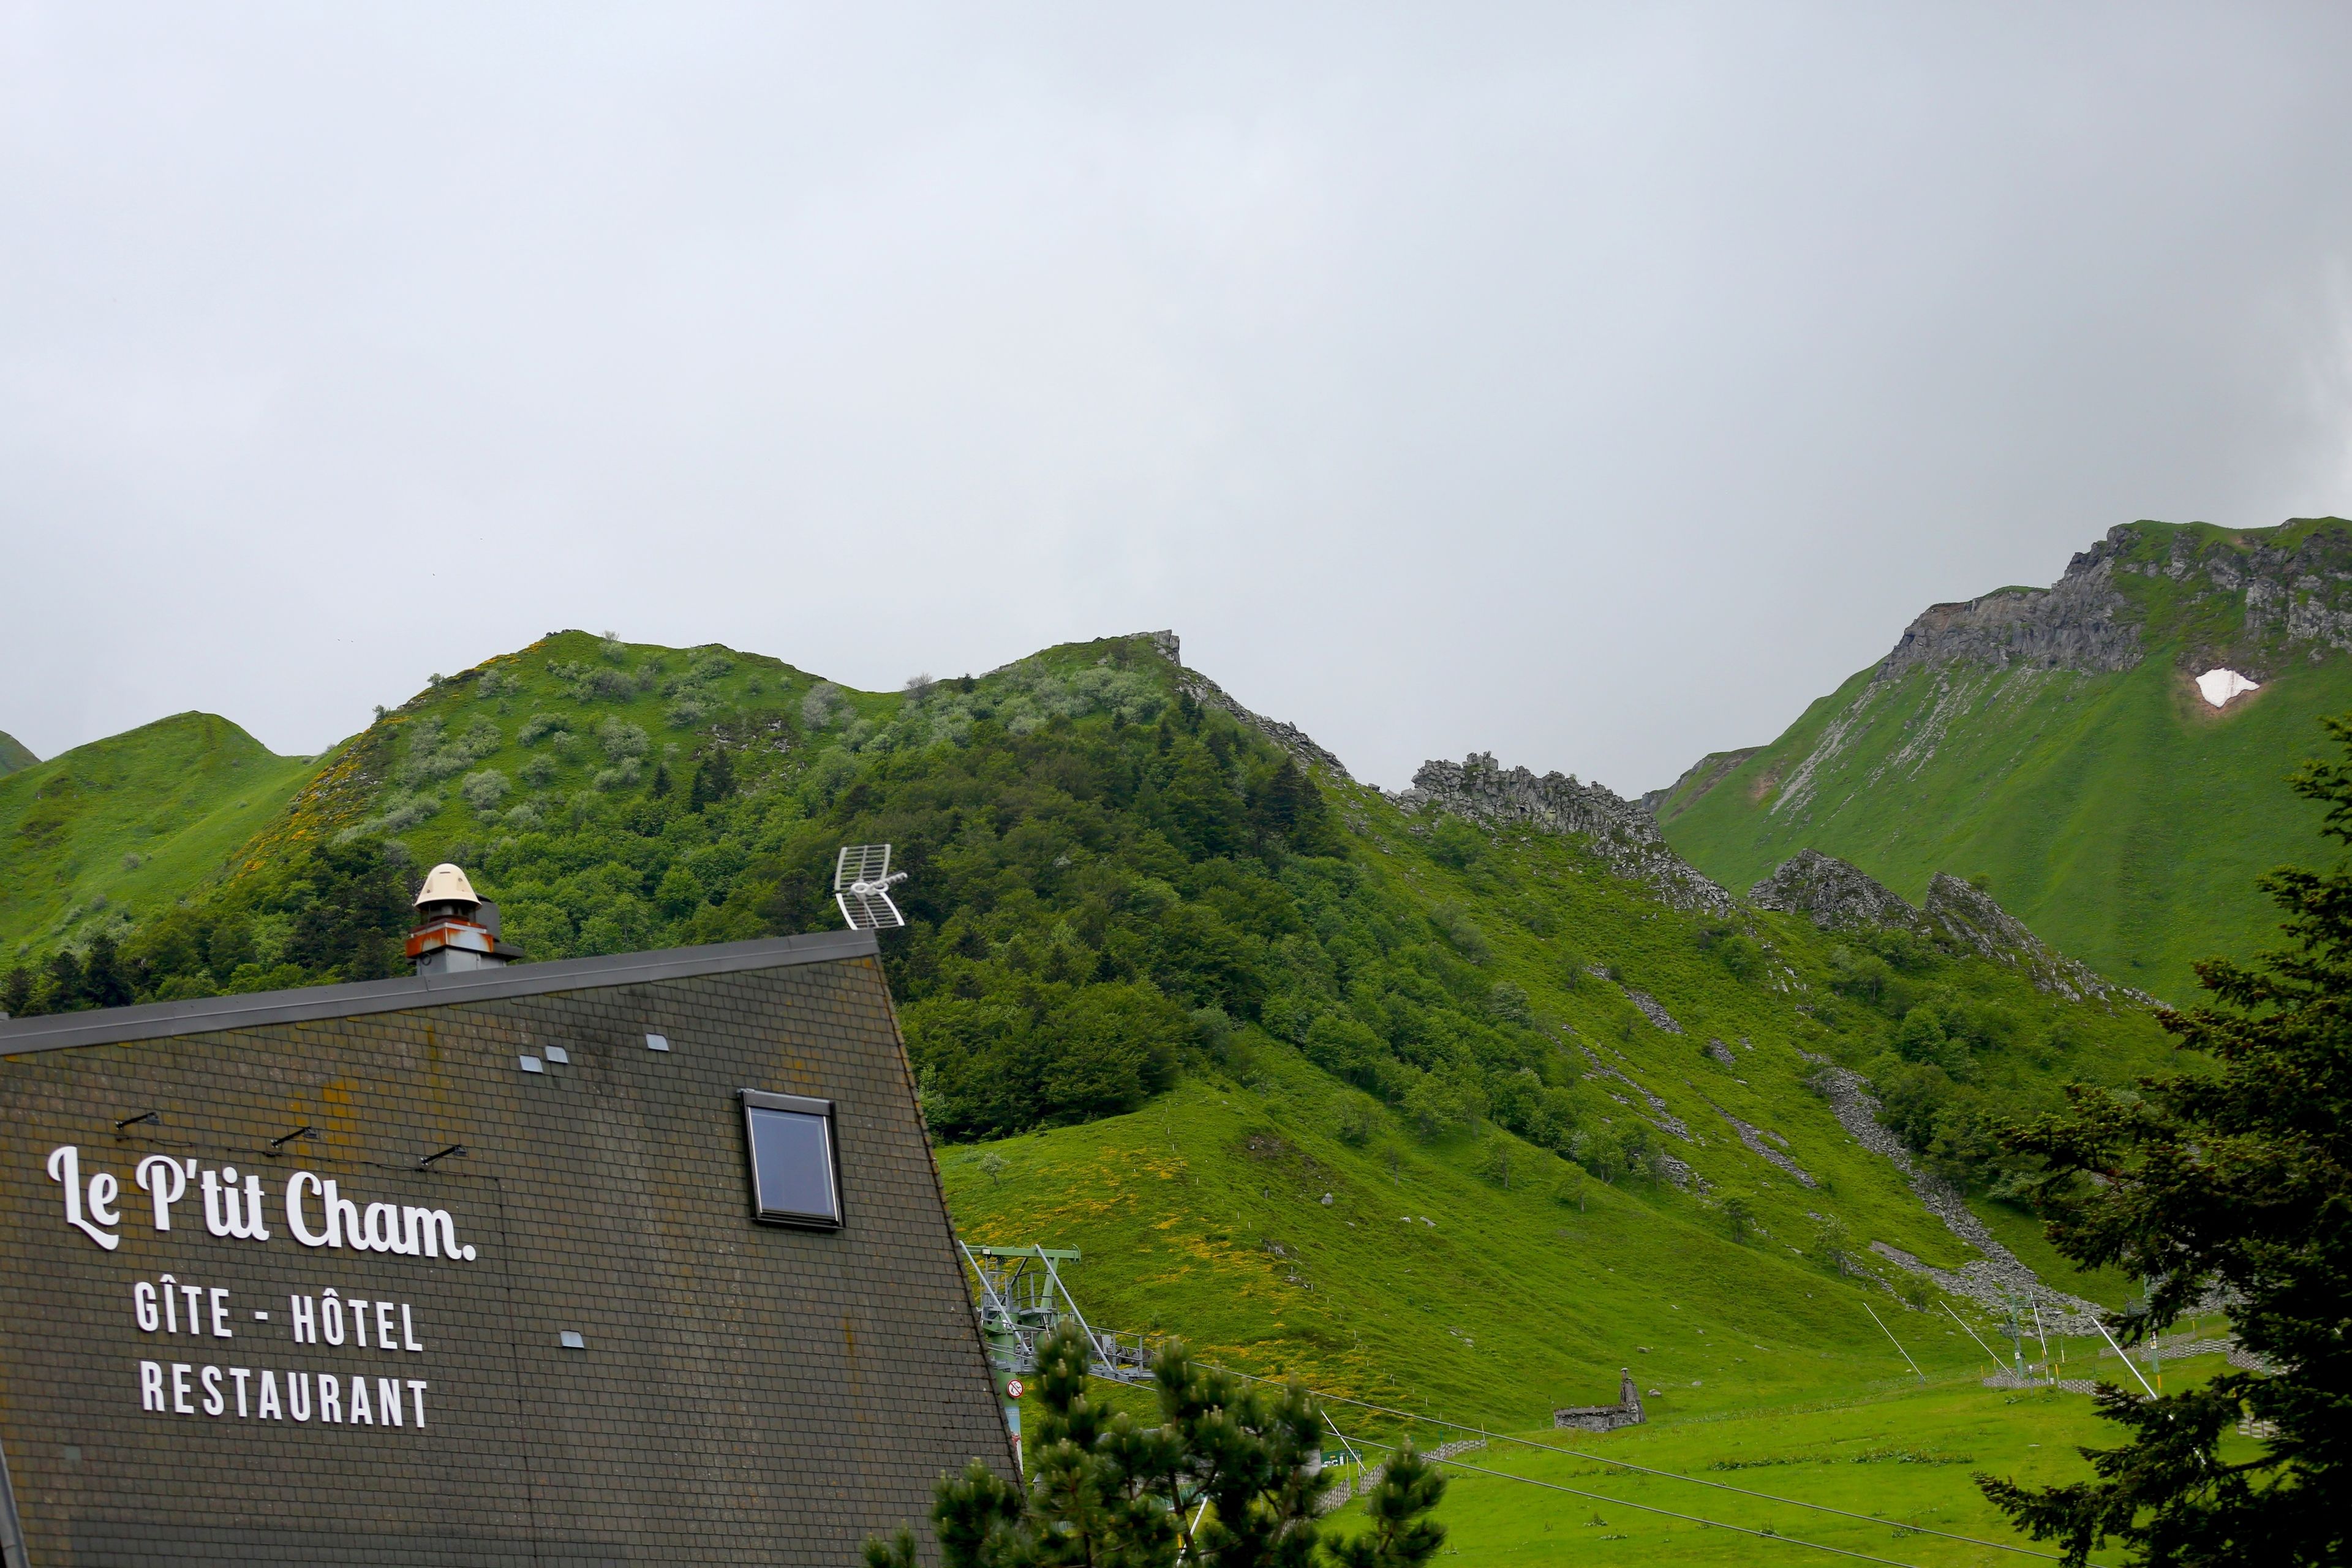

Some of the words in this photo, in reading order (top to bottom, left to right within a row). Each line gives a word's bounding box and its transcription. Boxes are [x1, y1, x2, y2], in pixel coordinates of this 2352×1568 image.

[48, 1146, 120, 1250] Le
[136, 1155, 270, 1241] P'tit
[286, 1171, 477, 1261] Cham.
[134, 1274, 232, 1337] GÎTE
[291, 1287, 423, 1351] HÔTEL
[140, 1361, 428, 1428] RESTAURANT
